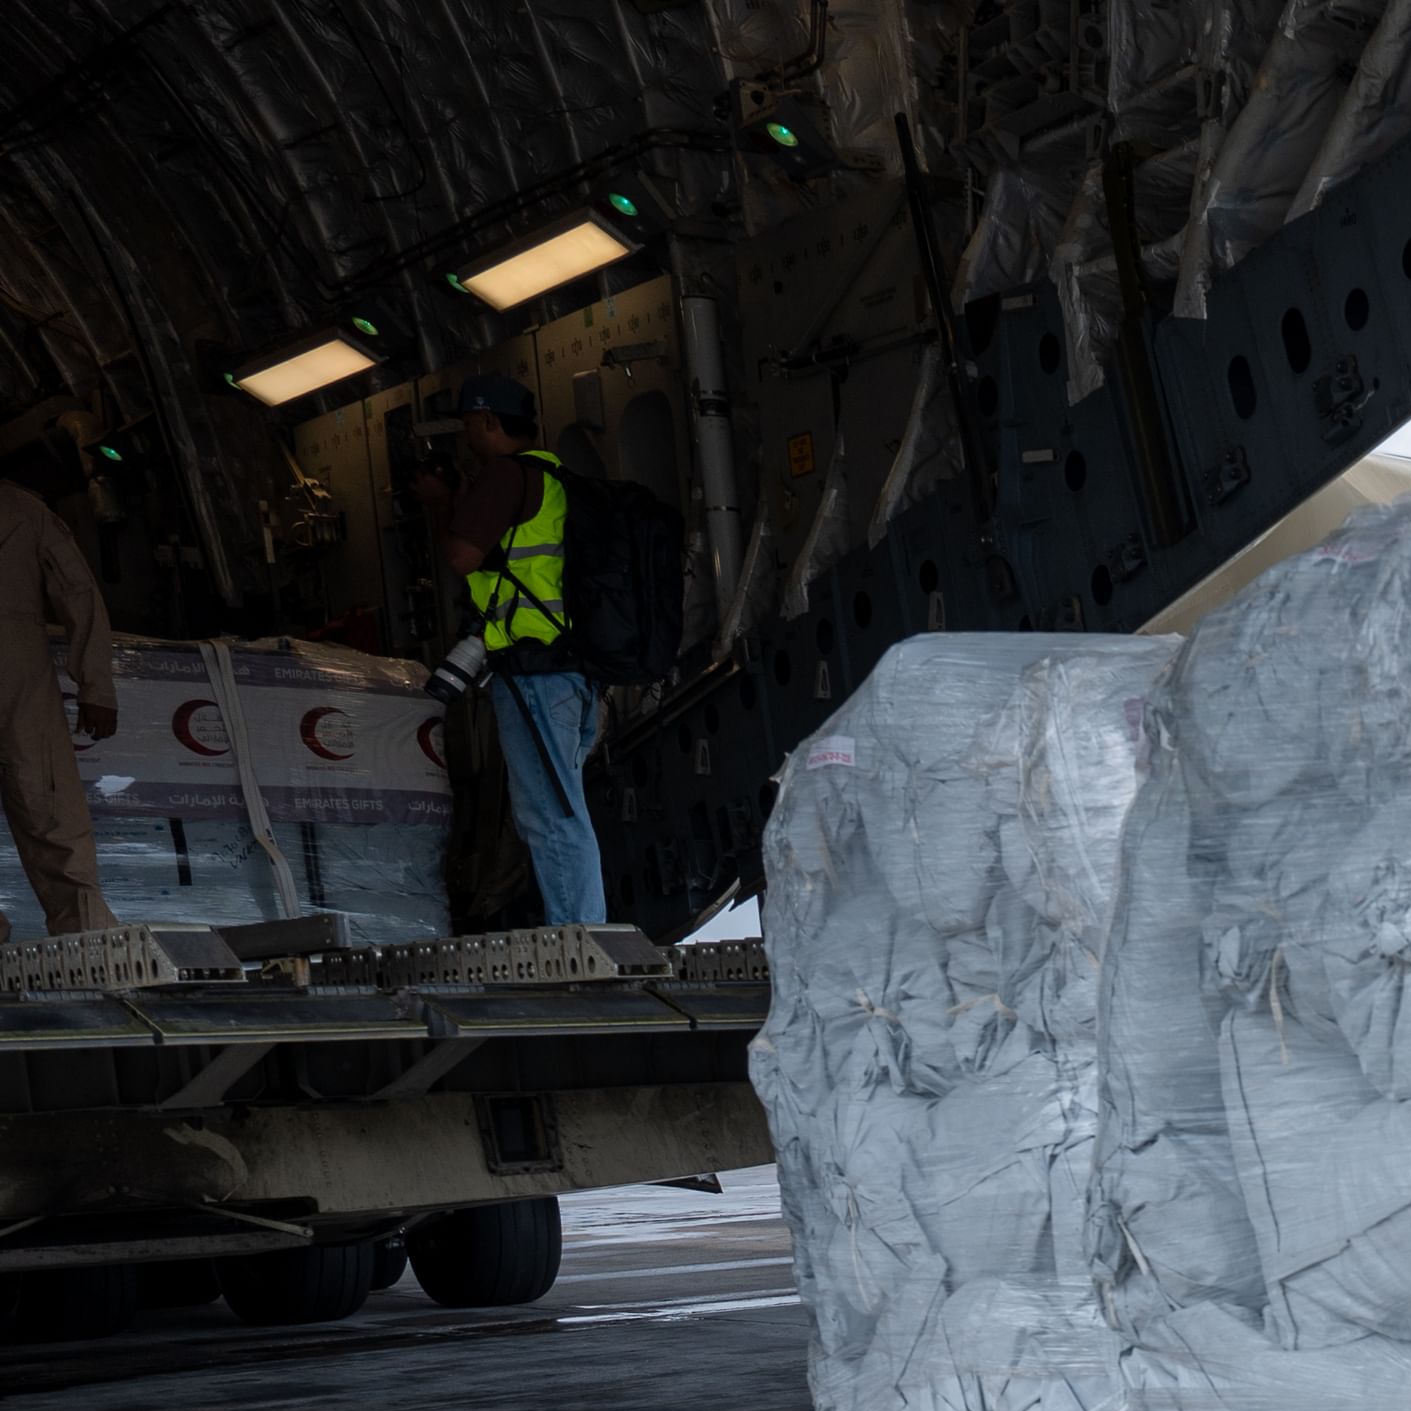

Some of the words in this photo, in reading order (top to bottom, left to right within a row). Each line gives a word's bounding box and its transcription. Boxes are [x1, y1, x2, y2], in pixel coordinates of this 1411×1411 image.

[274, 667, 331, 682] EMIRATES
[295, 798, 349, 809] EMIRATES
[352, 799, 384, 811] GIFTS
